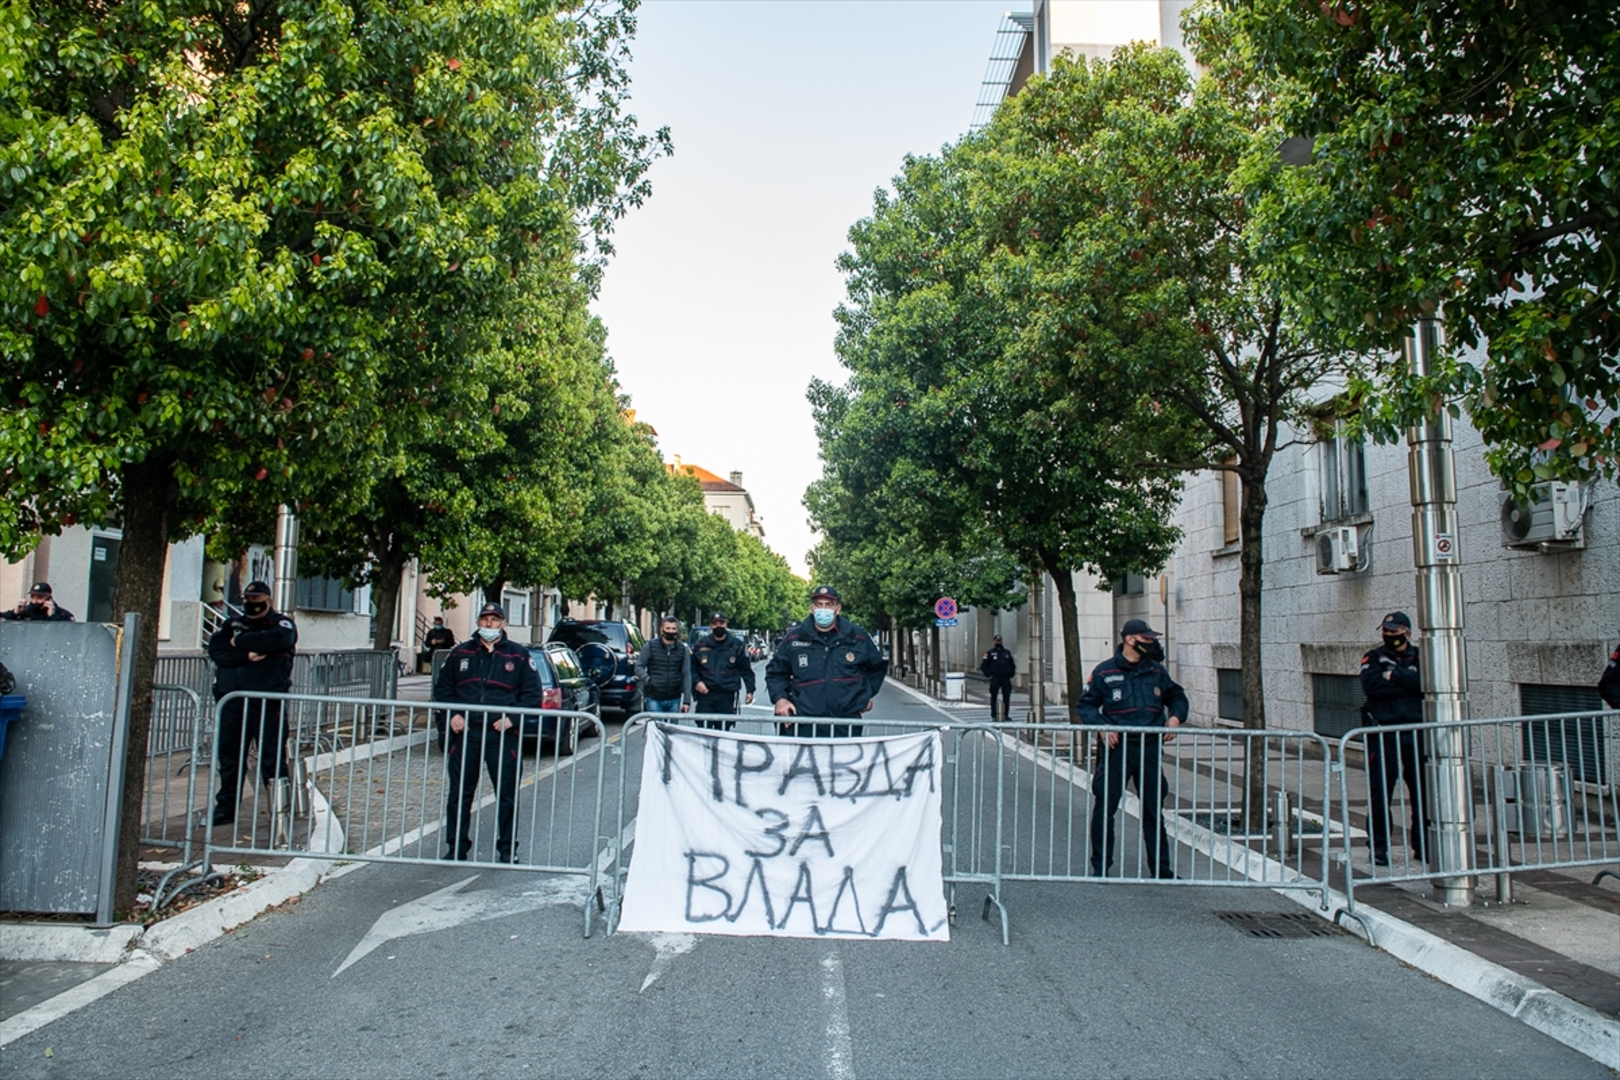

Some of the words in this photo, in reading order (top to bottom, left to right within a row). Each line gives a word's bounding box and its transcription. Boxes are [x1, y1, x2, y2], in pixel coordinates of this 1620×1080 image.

[659, 727, 935, 807] ПРАВДА
[745, 805, 834, 858] ЗА
[684, 852, 928, 937] ВЛАДА
